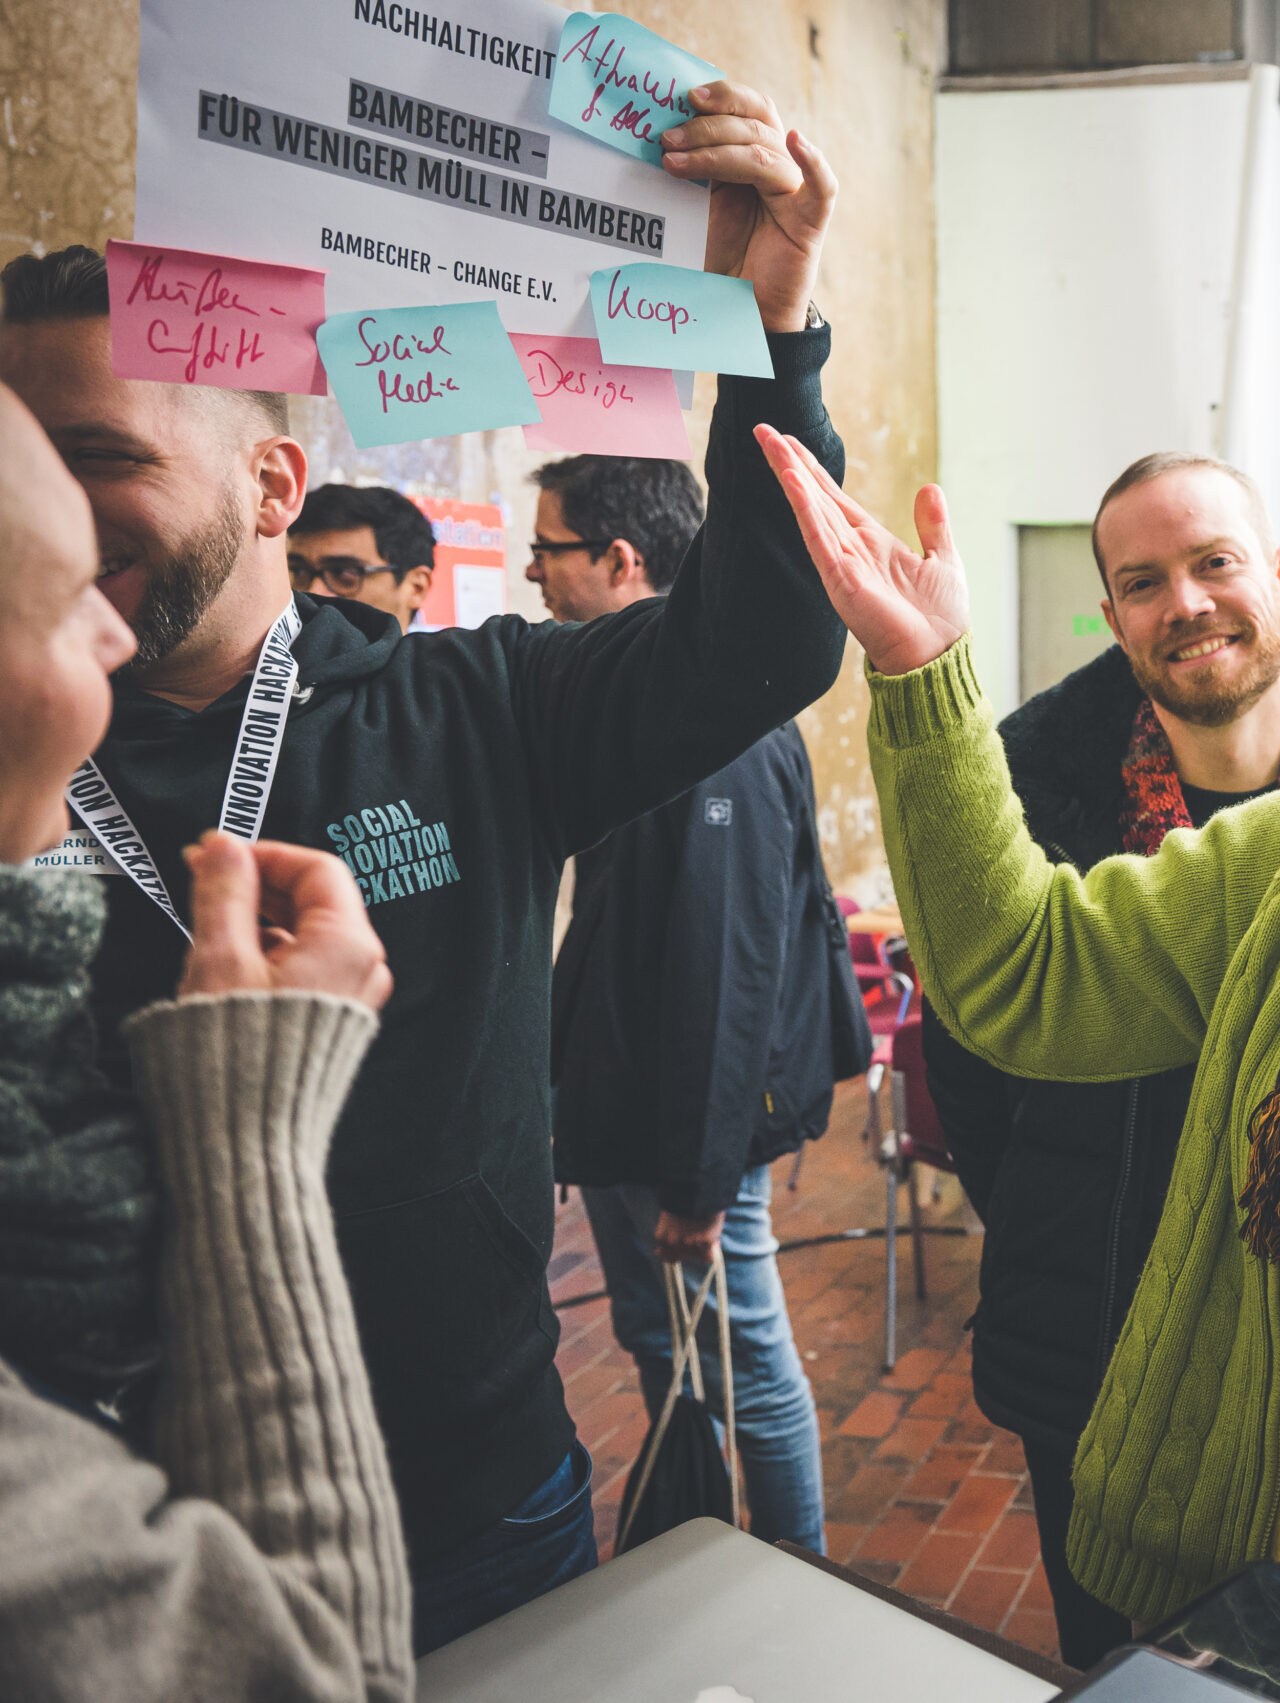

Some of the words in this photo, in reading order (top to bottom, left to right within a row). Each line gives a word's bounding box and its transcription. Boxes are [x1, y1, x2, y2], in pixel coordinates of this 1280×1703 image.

[354, 0, 556, 79] NACHHALTIGKEIT
[350, 83, 521, 164] BAMBECHER
[200, 93, 262, 146] FÜR
[272, 114, 408, 186] WENIGER
[417, 157, 492, 208] MÜLL
[501, 179, 529, 217] IN
[538, 189, 664, 251] BAMBERG
[321, 227, 431, 275] BAMBECHER
[453, 260, 522, 295] CHANGE
[527, 277, 557, 303] E.V.
[355, 317, 452, 366] Social
[528, 349, 634, 409] Design
[222, 708, 281, 839] INNOVATION
[252, 615, 294, 704] HACKATHON
[34, 853, 106, 867] MÜLLER
[326, 799, 421, 853] SOCIAL
